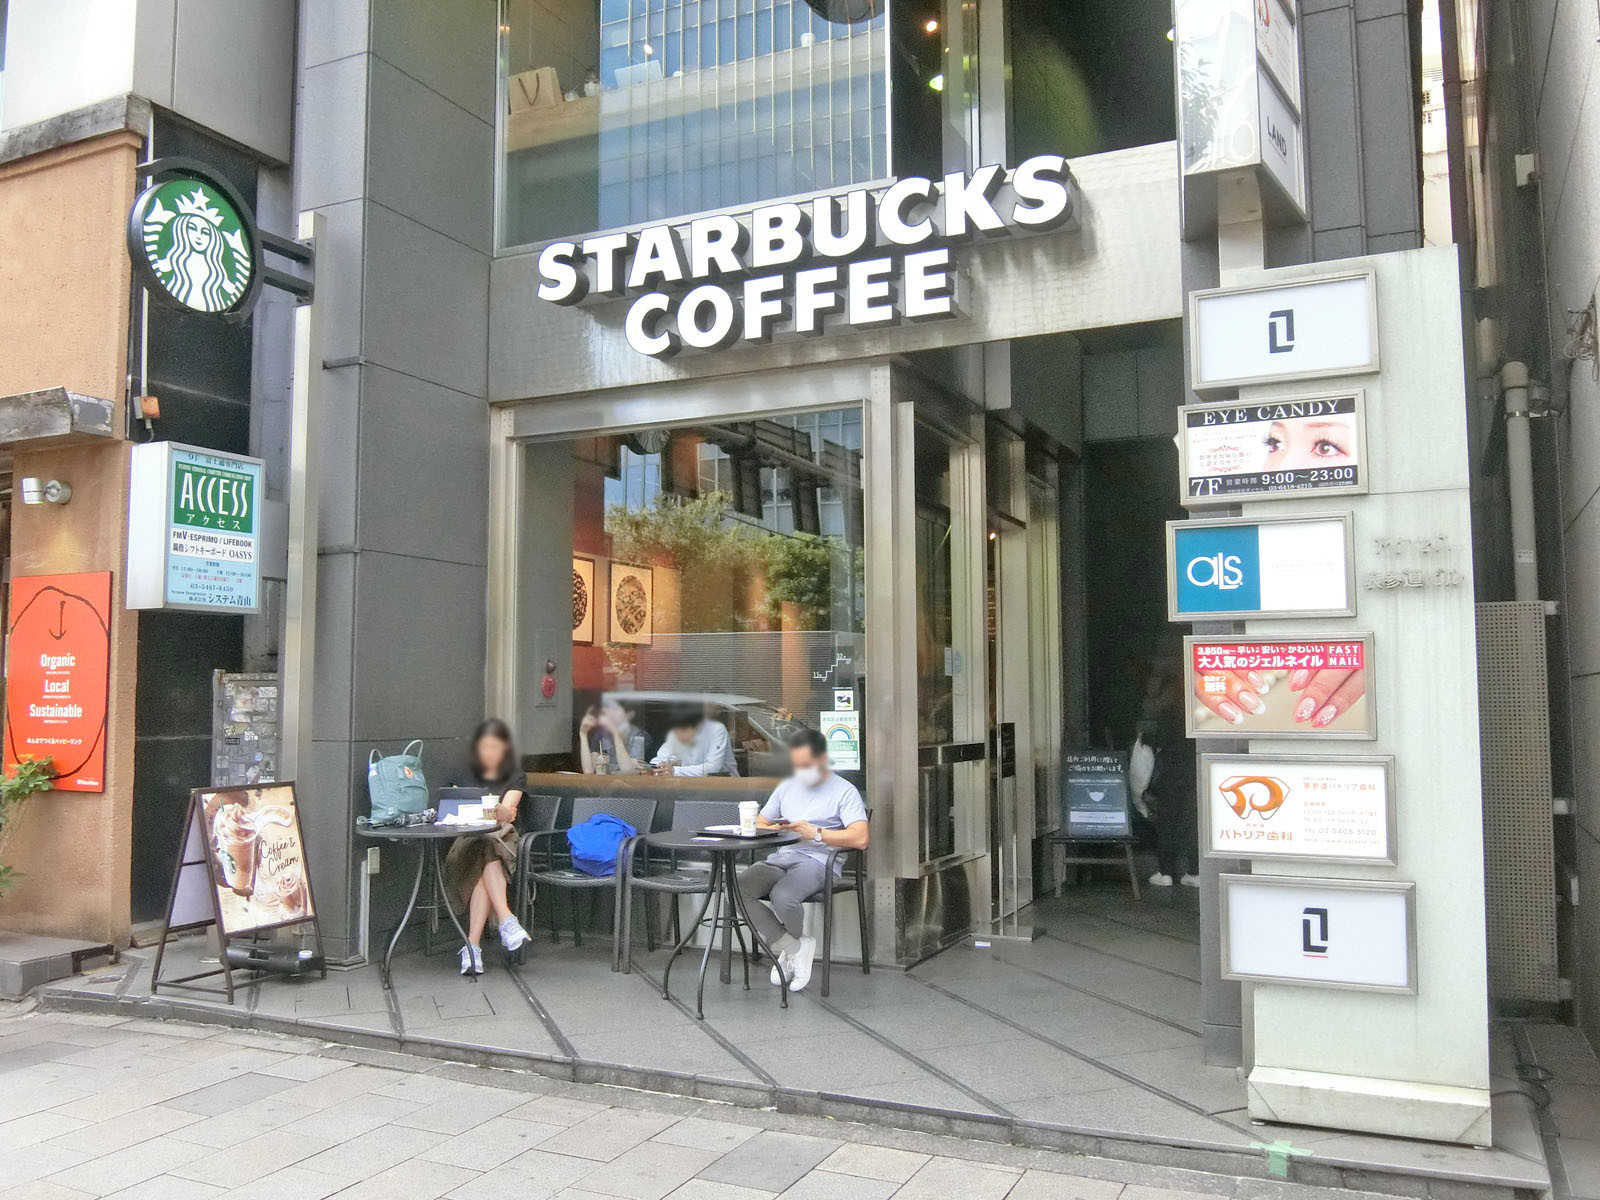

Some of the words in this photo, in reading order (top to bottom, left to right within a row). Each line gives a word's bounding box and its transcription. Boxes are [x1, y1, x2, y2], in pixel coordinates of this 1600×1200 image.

[1266, 115, 1288, 156] LAND
[537, 154, 1071, 303] STARBUCKS
[624, 248, 952, 356] COFFEE
[1203, 407, 1248, 425] EYE
[1257, 400, 1339, 420] CANDY
[180, 472, 248, 518] ACCESS
[1191, 478, 1223, 497] 7F
[186, 513, 241, 530] アクセス
[223, 537, 252, 548] LIFEBOOK
[228, 549, 253, 560] OASYS
[1329, 645, 1359, 655] FAST
[40, 653, 76, 670] Organic
[1198, 655, 1324, 668] 大人気のジェルネイル
[1329, 657, 1360, 667] NAIL
[44, 680, 71, 693] Local
[29, 703, 83, 718] Sustainable
[1219, 830, 1293, 841] パトリア歯科
[261, 840, 289, 861] Coffee
[268, 857, 299, 876] Cream
